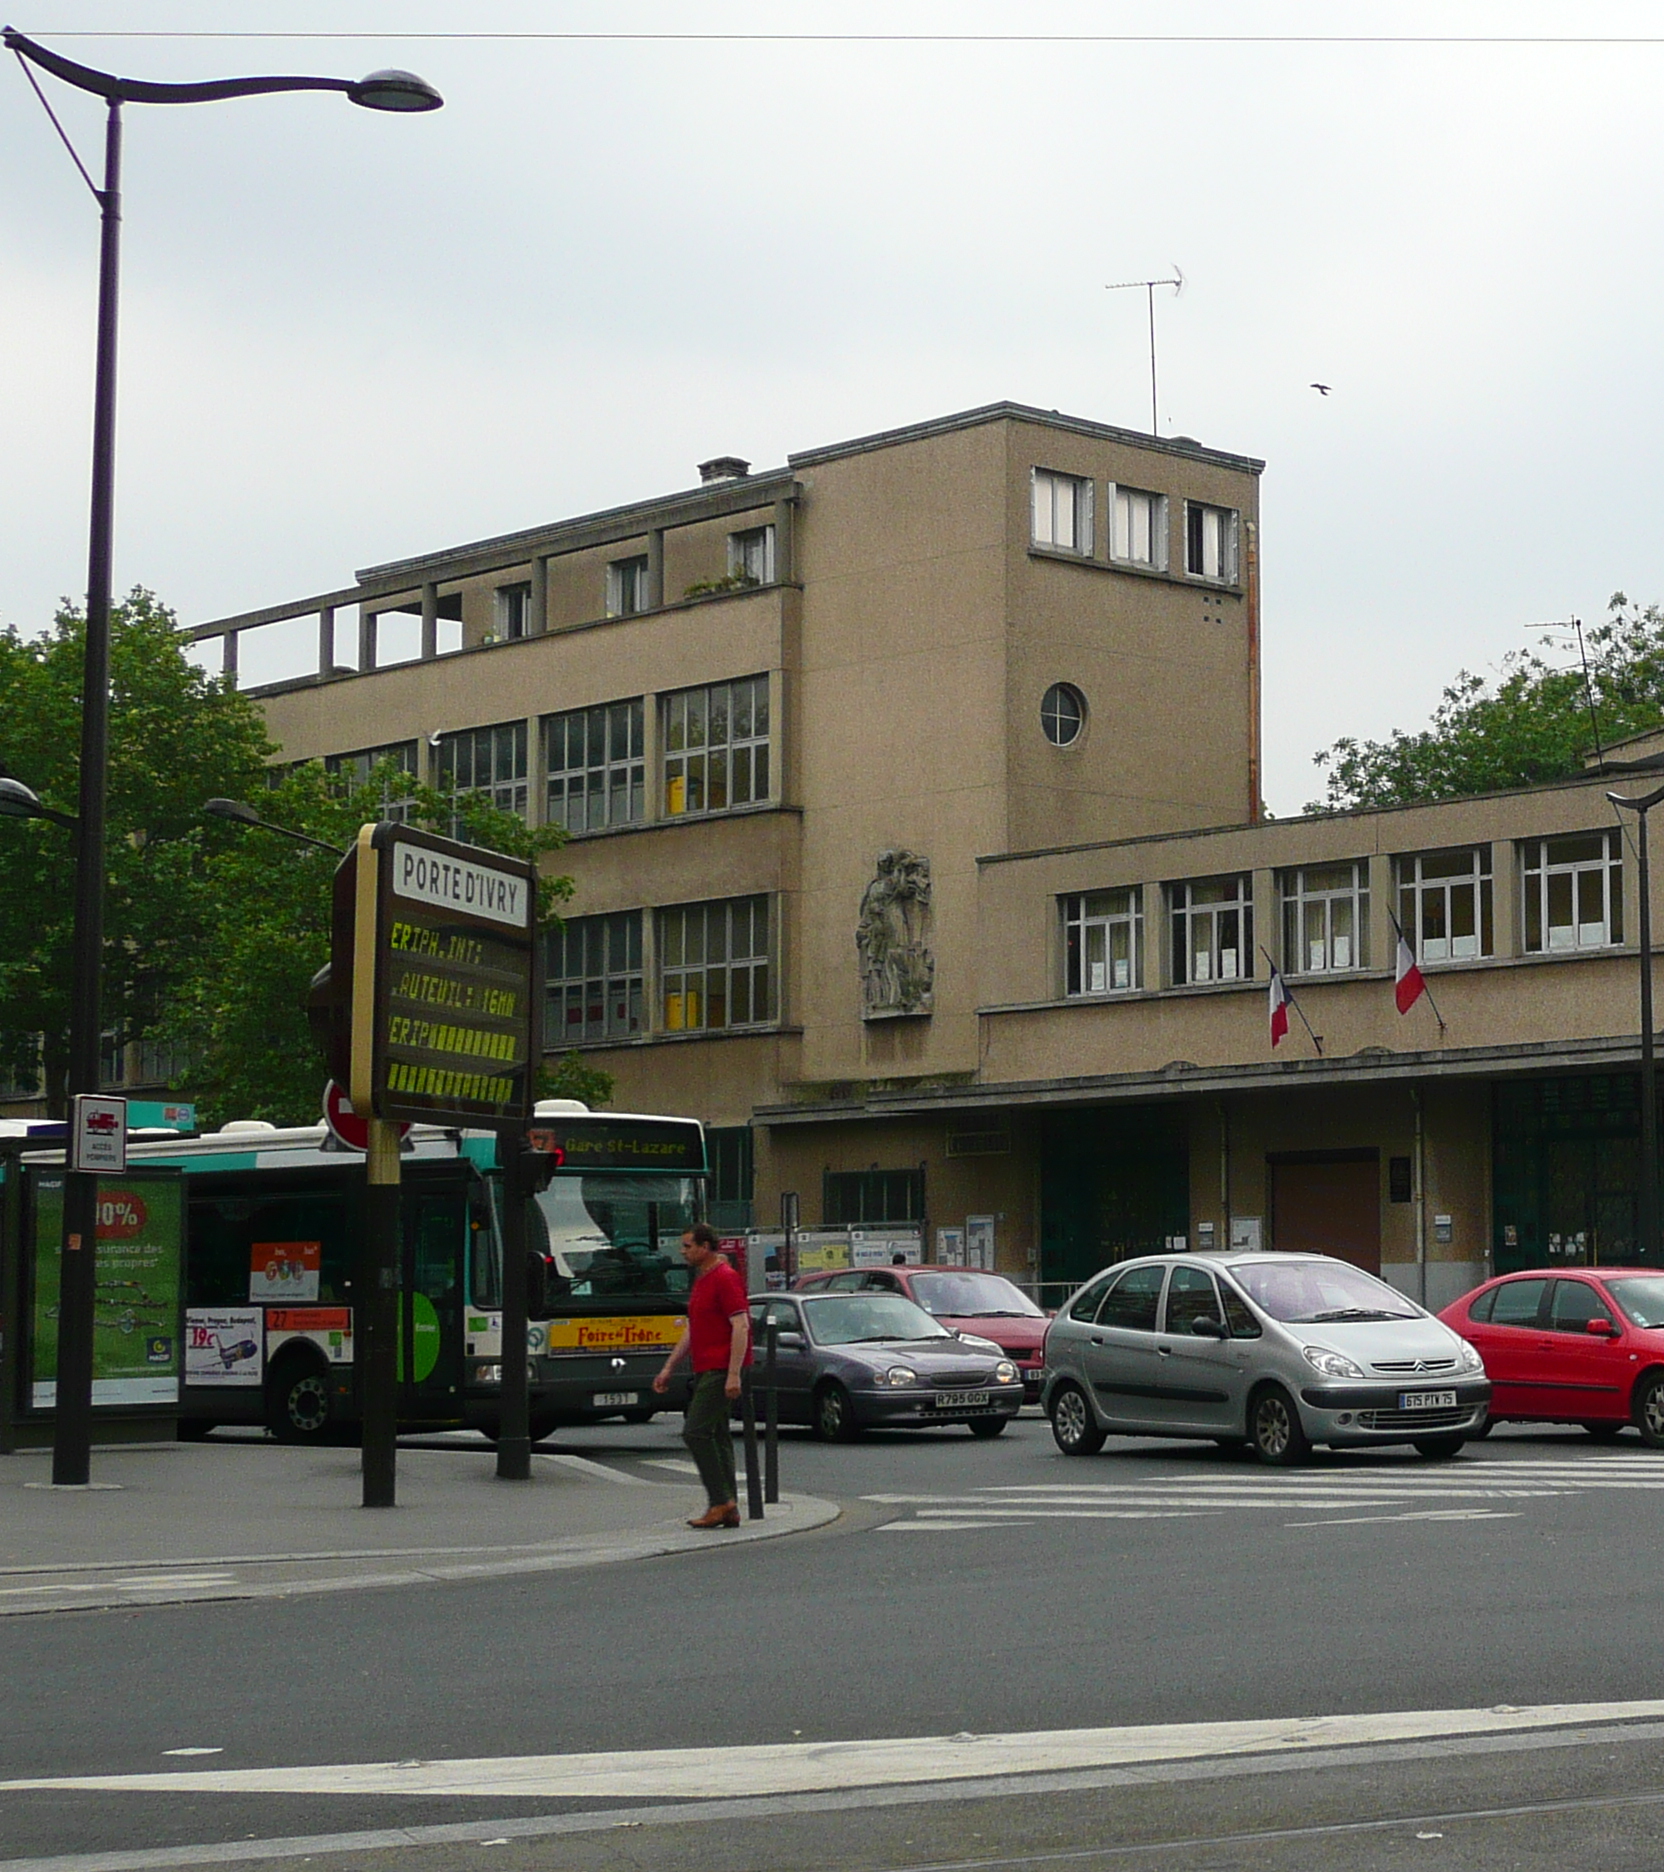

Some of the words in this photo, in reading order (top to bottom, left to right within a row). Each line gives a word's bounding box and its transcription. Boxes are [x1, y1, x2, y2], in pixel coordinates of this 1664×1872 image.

[404, 853, 461, 900] PORTE
[465, 871, 517, 914] D'IVRY
[566, 1138, 602, 1152] Gare
[607, 1139, 686, 1154] St-Lazare
[273, 1311, 287, 1327] 27
[577, 1327, 614, 1345] Foire
[623, 1325, 663, 1343] Trône
[937, 1393, 966, 1405] R795
[1442, 1393, 1453, 1404] 75
